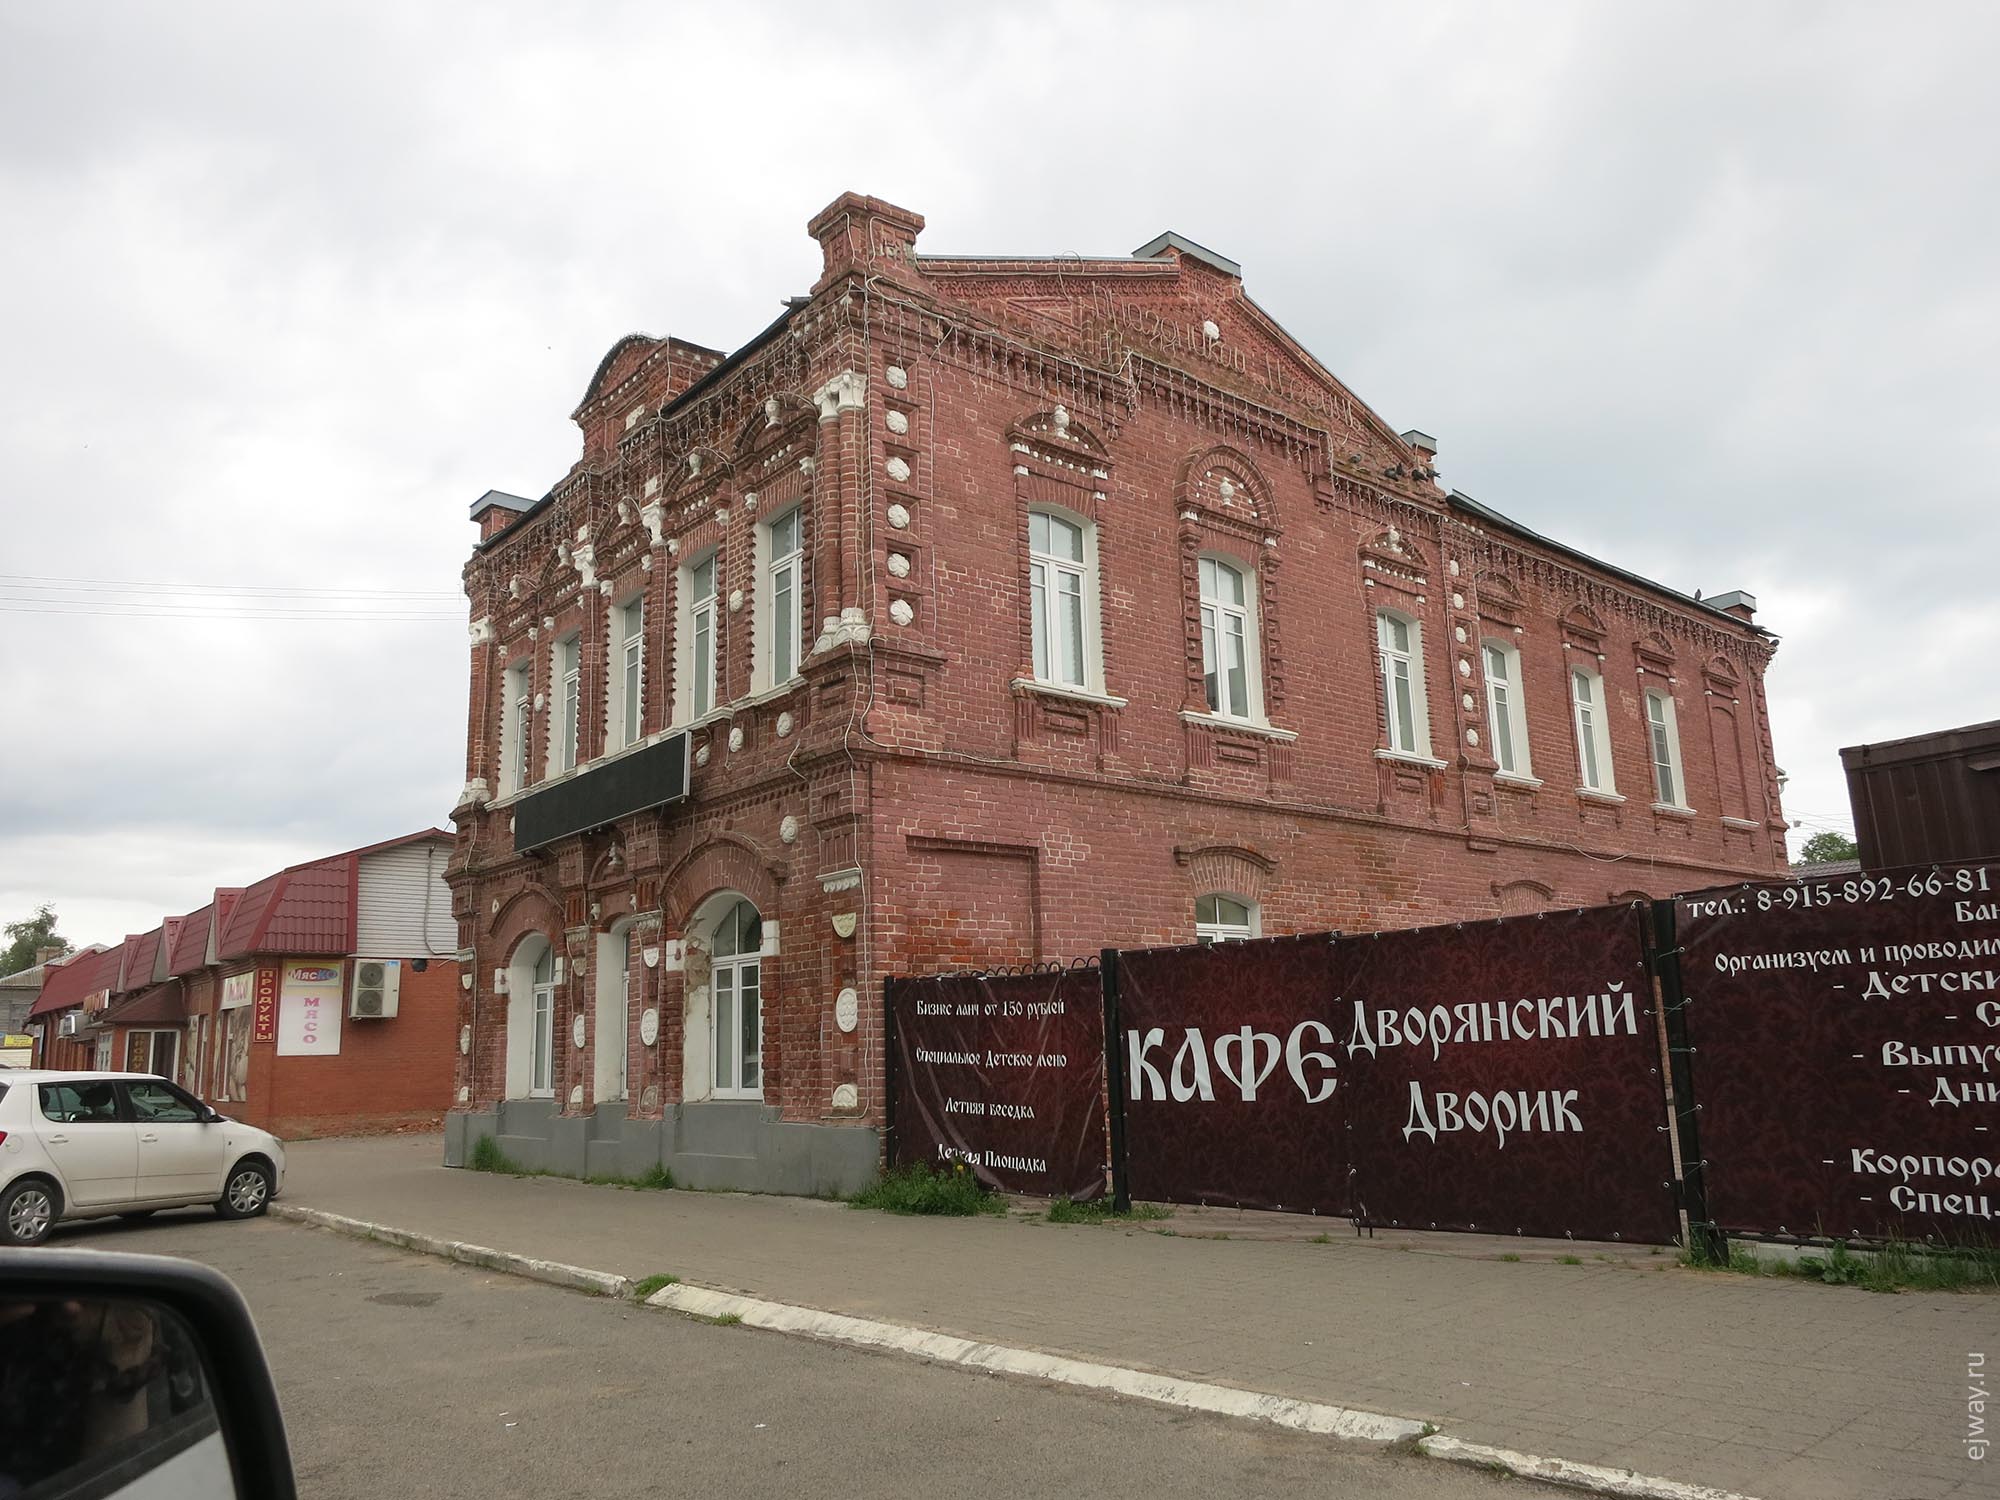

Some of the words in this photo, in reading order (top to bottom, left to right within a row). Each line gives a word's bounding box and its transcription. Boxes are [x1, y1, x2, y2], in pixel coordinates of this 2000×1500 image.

[1756, 867, 1991, 912] 8-915-892-66-81
[1714, 948, 1852, 977] Организуем
[1860, 947, 1875, 963] и
[256, 970, 273, 1040] ПРОДУКТЫ
[303, 997, 320, 1044] МЯСО
[956, 1003, 980, 1017] ланч
[984, 1003, 999, 1017] от
[1002, 1001, 1023, 1017] 150
[1027, 998, 1065, 1020] рублей
[1346, 980, 1638, 1062] Дворянский
[916, 1047, 981, 1066] Специальное
[985, 1050, 1033, 1069] Детское
[945, 1097, 985, 1116] Летняя
[989, 1101, 1035, 1120] беседка
[1401, 1081, 1584, 1149] Дворик
[985, 1150, 1047, 1173] Площадка
